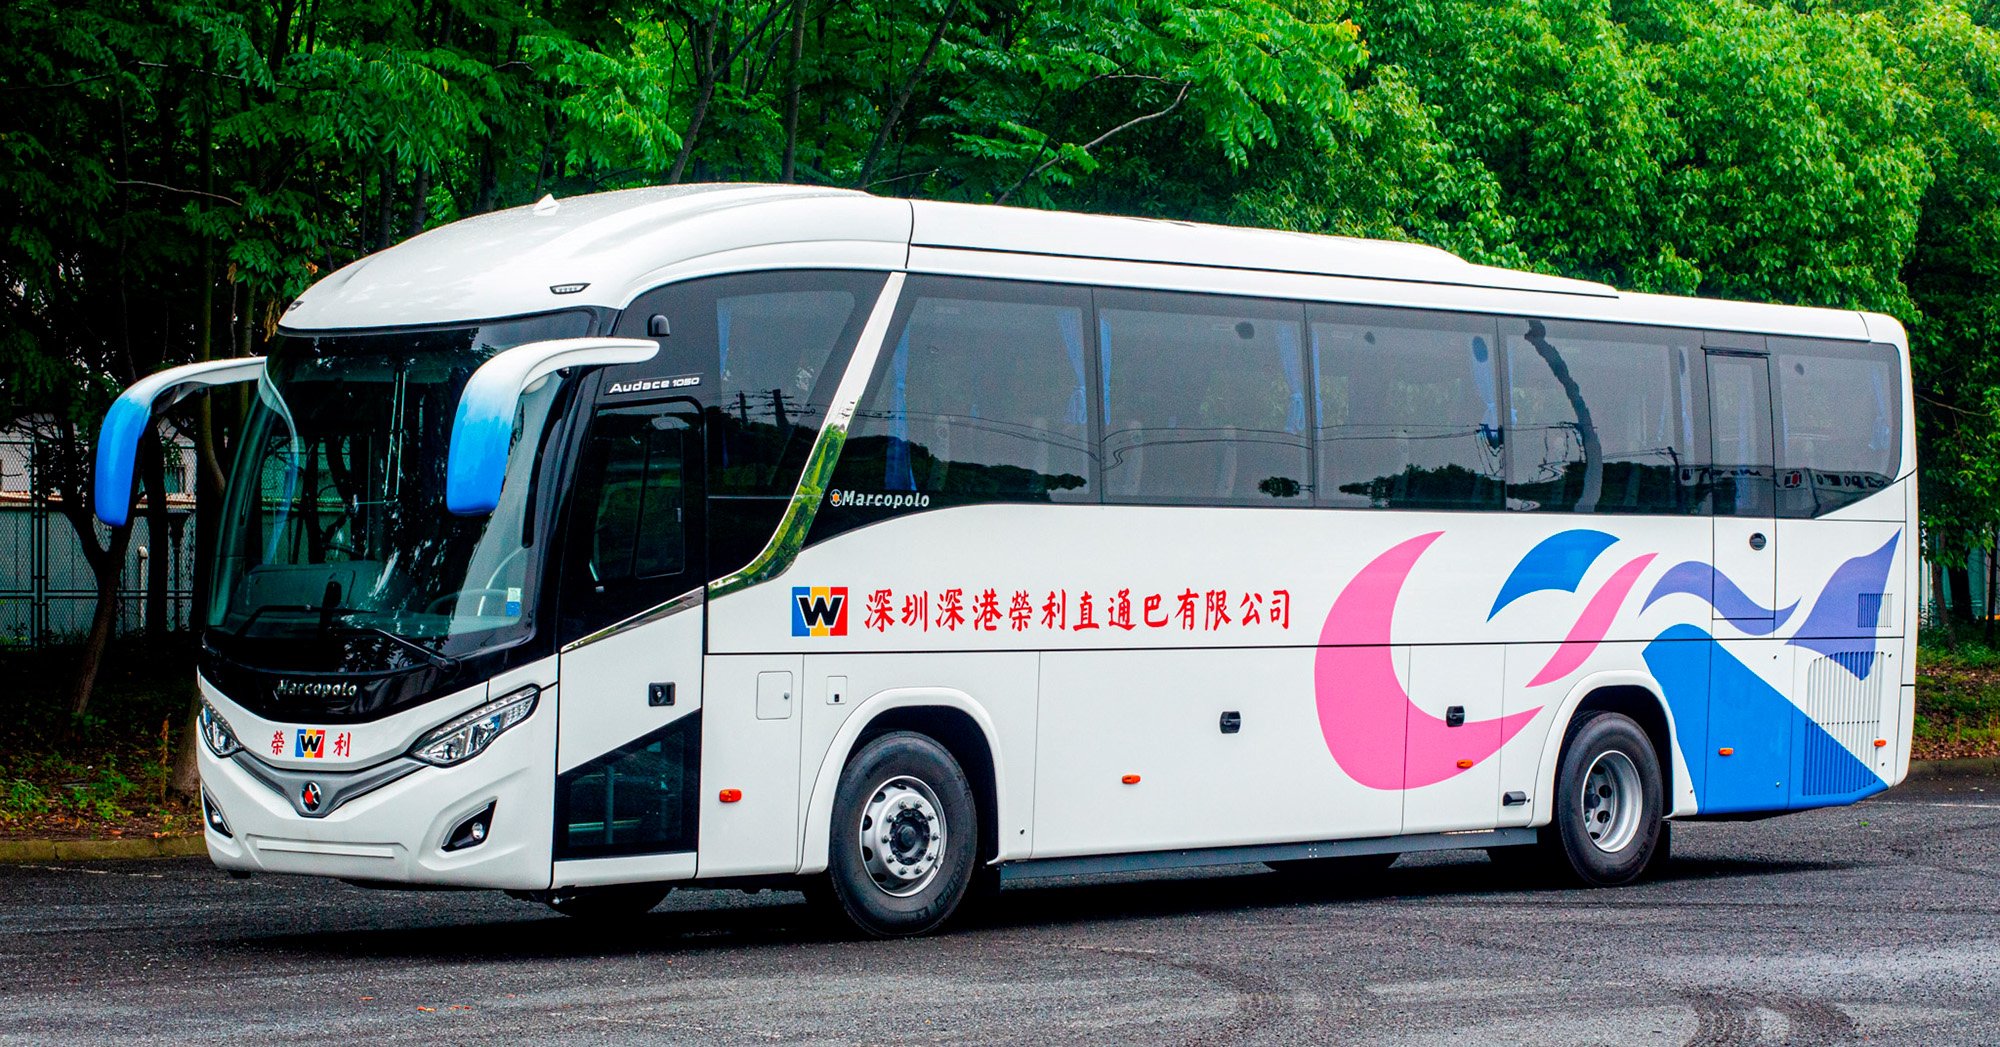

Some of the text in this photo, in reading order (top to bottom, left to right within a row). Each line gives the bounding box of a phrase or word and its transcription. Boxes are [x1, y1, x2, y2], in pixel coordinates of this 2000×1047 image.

[609, 377, 700, 394] Audace 1050
[842, 490, 930, 509] Marcopolo
[796, 596, 844, 628] W
[864, 587, 1290, 633] 深圳深港榮利直通巴有限公司
[277, 680, 357, 698] Marcopolo
[300, 734, 323, 753] W
[333, 731, 352, 758] 利
